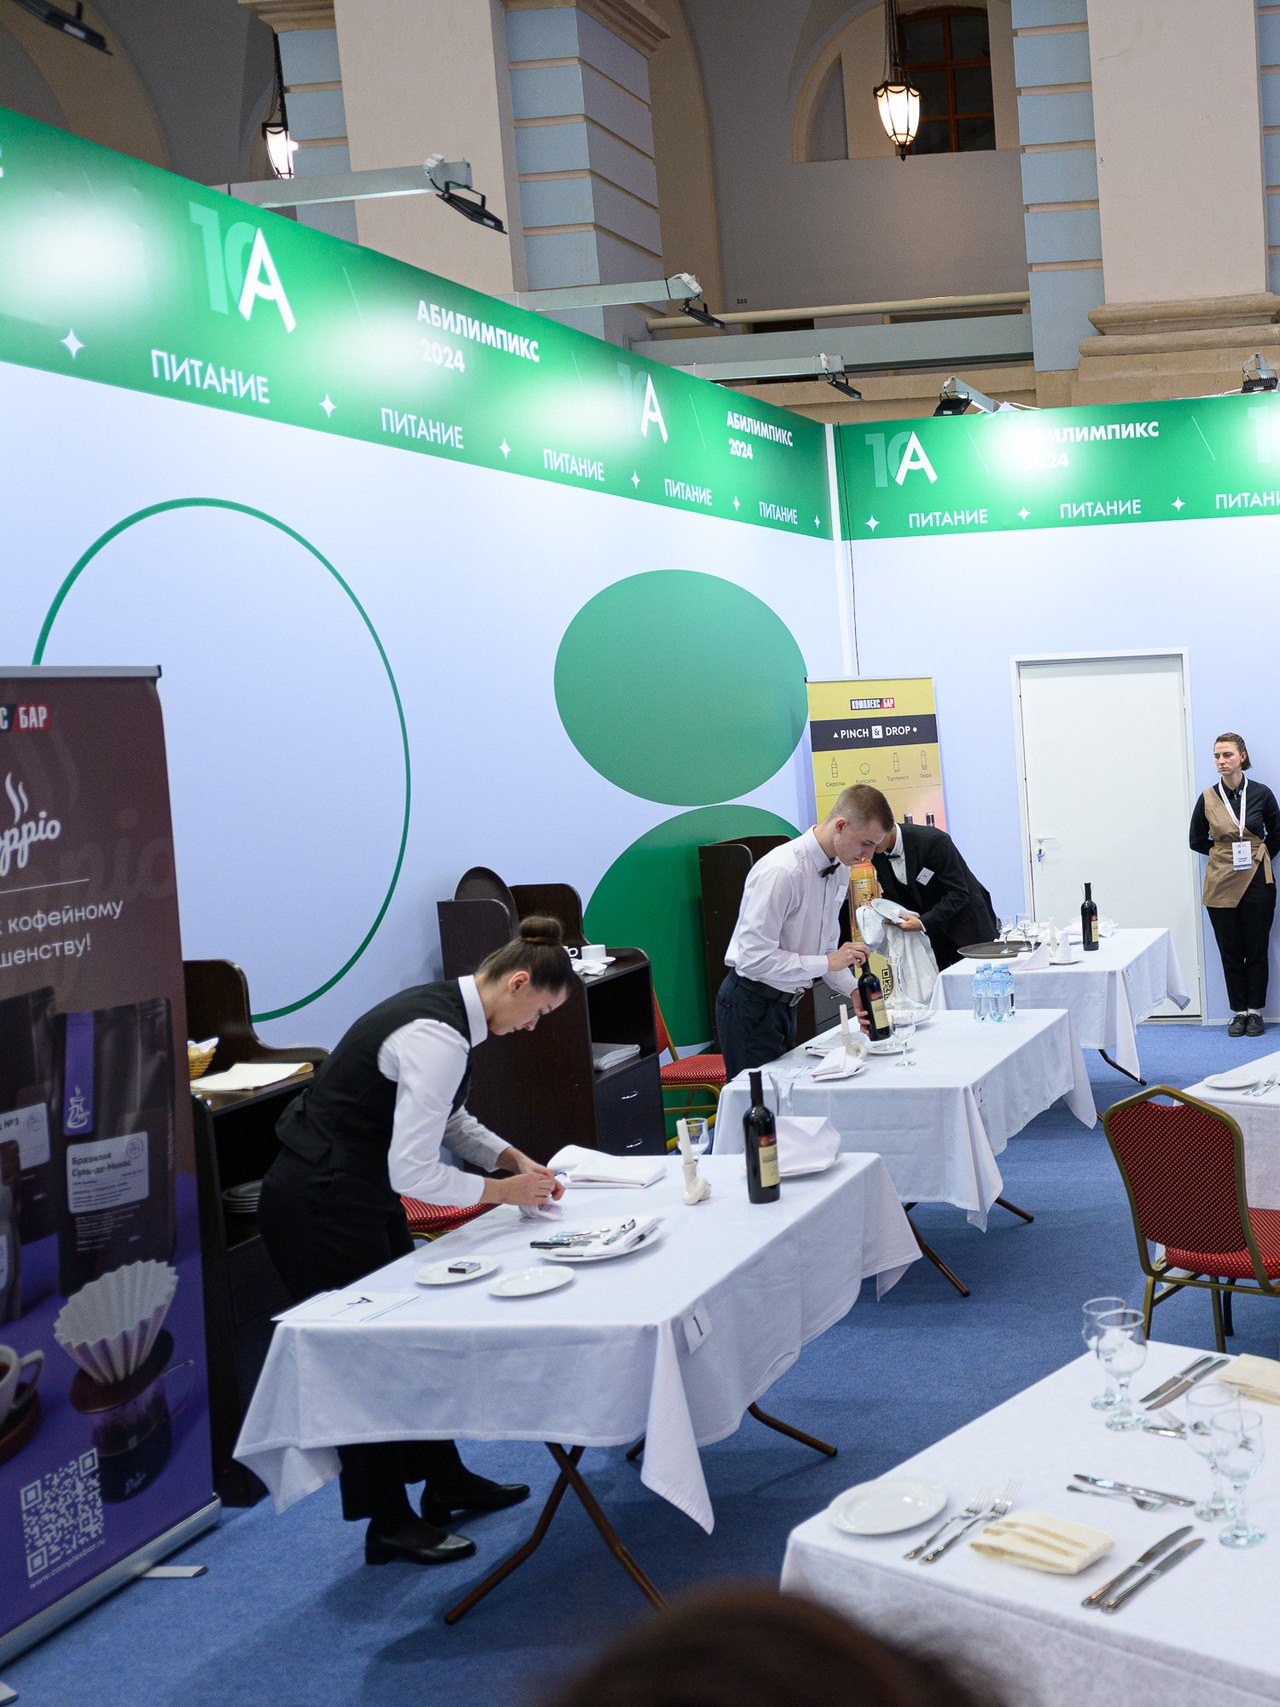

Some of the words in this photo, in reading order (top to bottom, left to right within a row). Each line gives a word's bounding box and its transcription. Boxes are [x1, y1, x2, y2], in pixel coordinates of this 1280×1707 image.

[417, 300, 540, 362] АБИЛИМПИКС
[419, 338, 465, 373] 2024
[151, 349, 270, 404] ПИТАНИЕ
[381, 408, 464, 449] ПИТАНИЕ
[543, 448, 605, 482] ПИТАНИЕ
[664, 478, 712, 506] ПИТАНИЕ
[759, 501, 798, 525] ПИТАНИЕ
[726, 411, 793, 447] АБИЛИМПИКС
[728, 438, 753, 460] 2024
[908, 509, 988, 528] ПИТАНИЕ
[1060, 499, 1142, 519] ПИТАНИЕ
[19, 706, 47, 728] БАР
[840, 728, 869, 739] PINCH
[885, 726, 911, 736] DROP
[0, 811, 61, 876] ppio
[8, 900, 124, 932] кофейному
